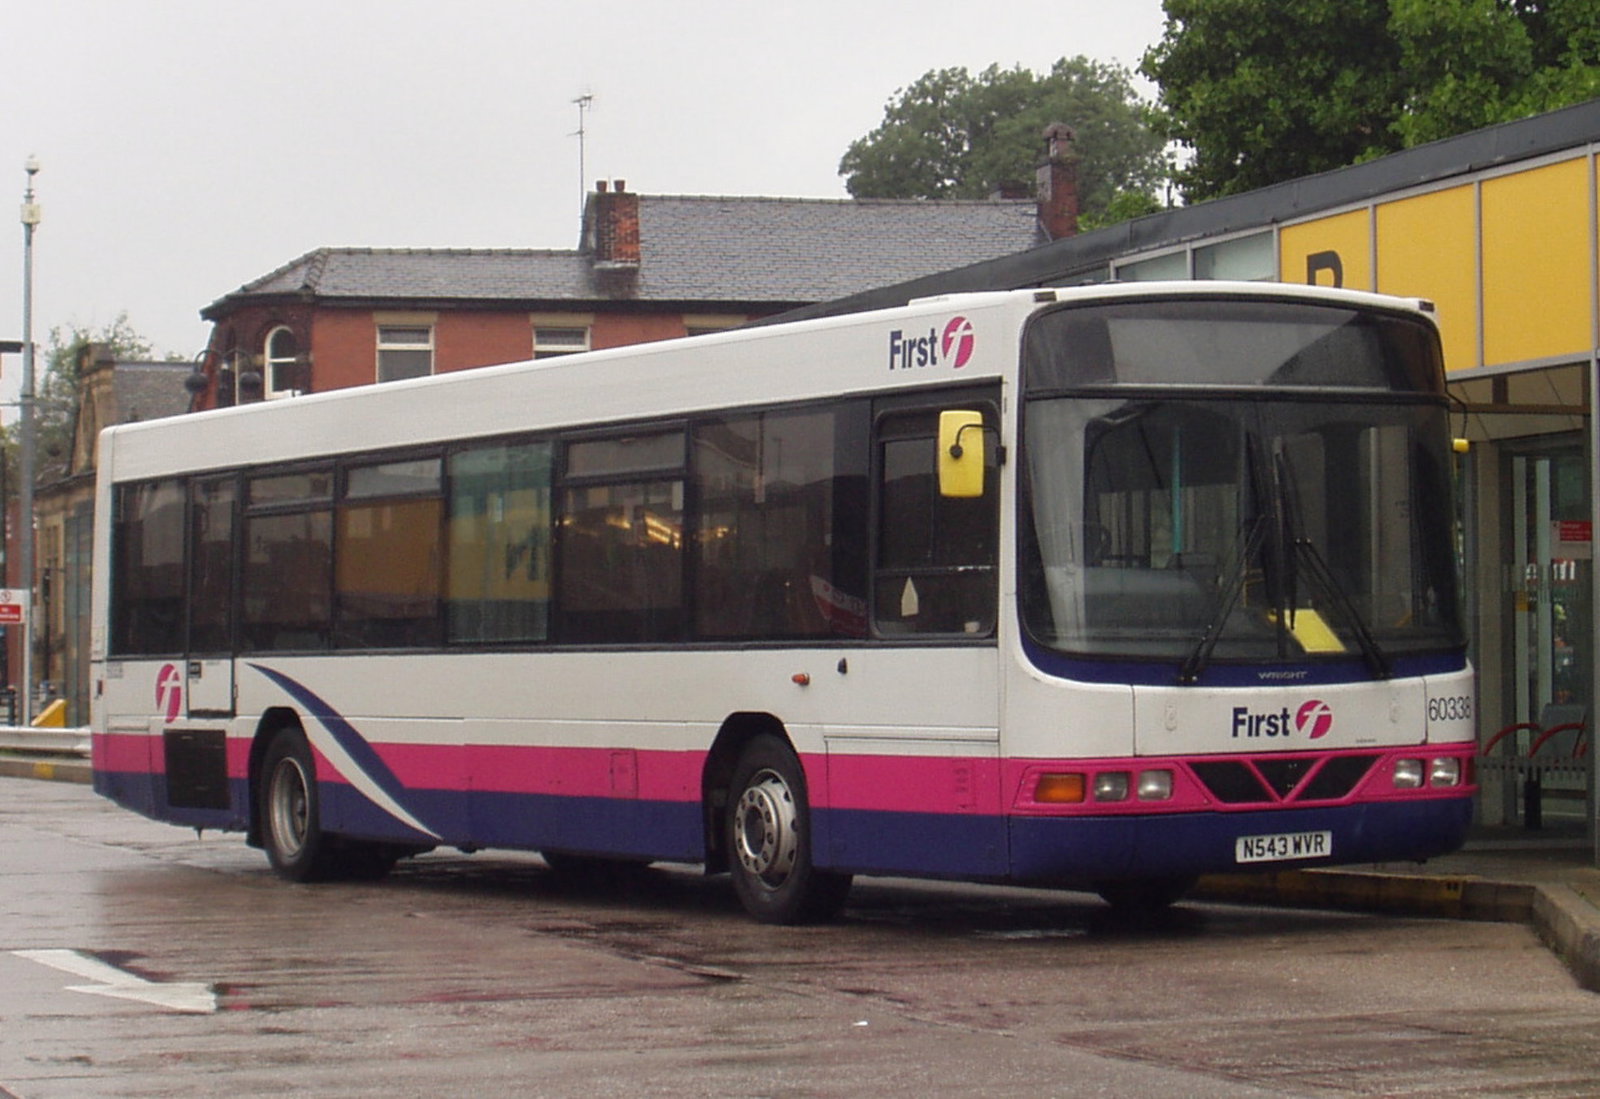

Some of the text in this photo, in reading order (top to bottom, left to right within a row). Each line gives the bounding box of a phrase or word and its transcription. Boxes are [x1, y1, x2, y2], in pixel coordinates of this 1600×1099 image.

[889, 327, 937, 370] First
[1258, 671, 1308, 680] WRIGHT
[1428, 696, 1471, 722] 60338
[1232, 707, 1290, 738] First
[1243, 834, 1324, 859] N543 WVR
